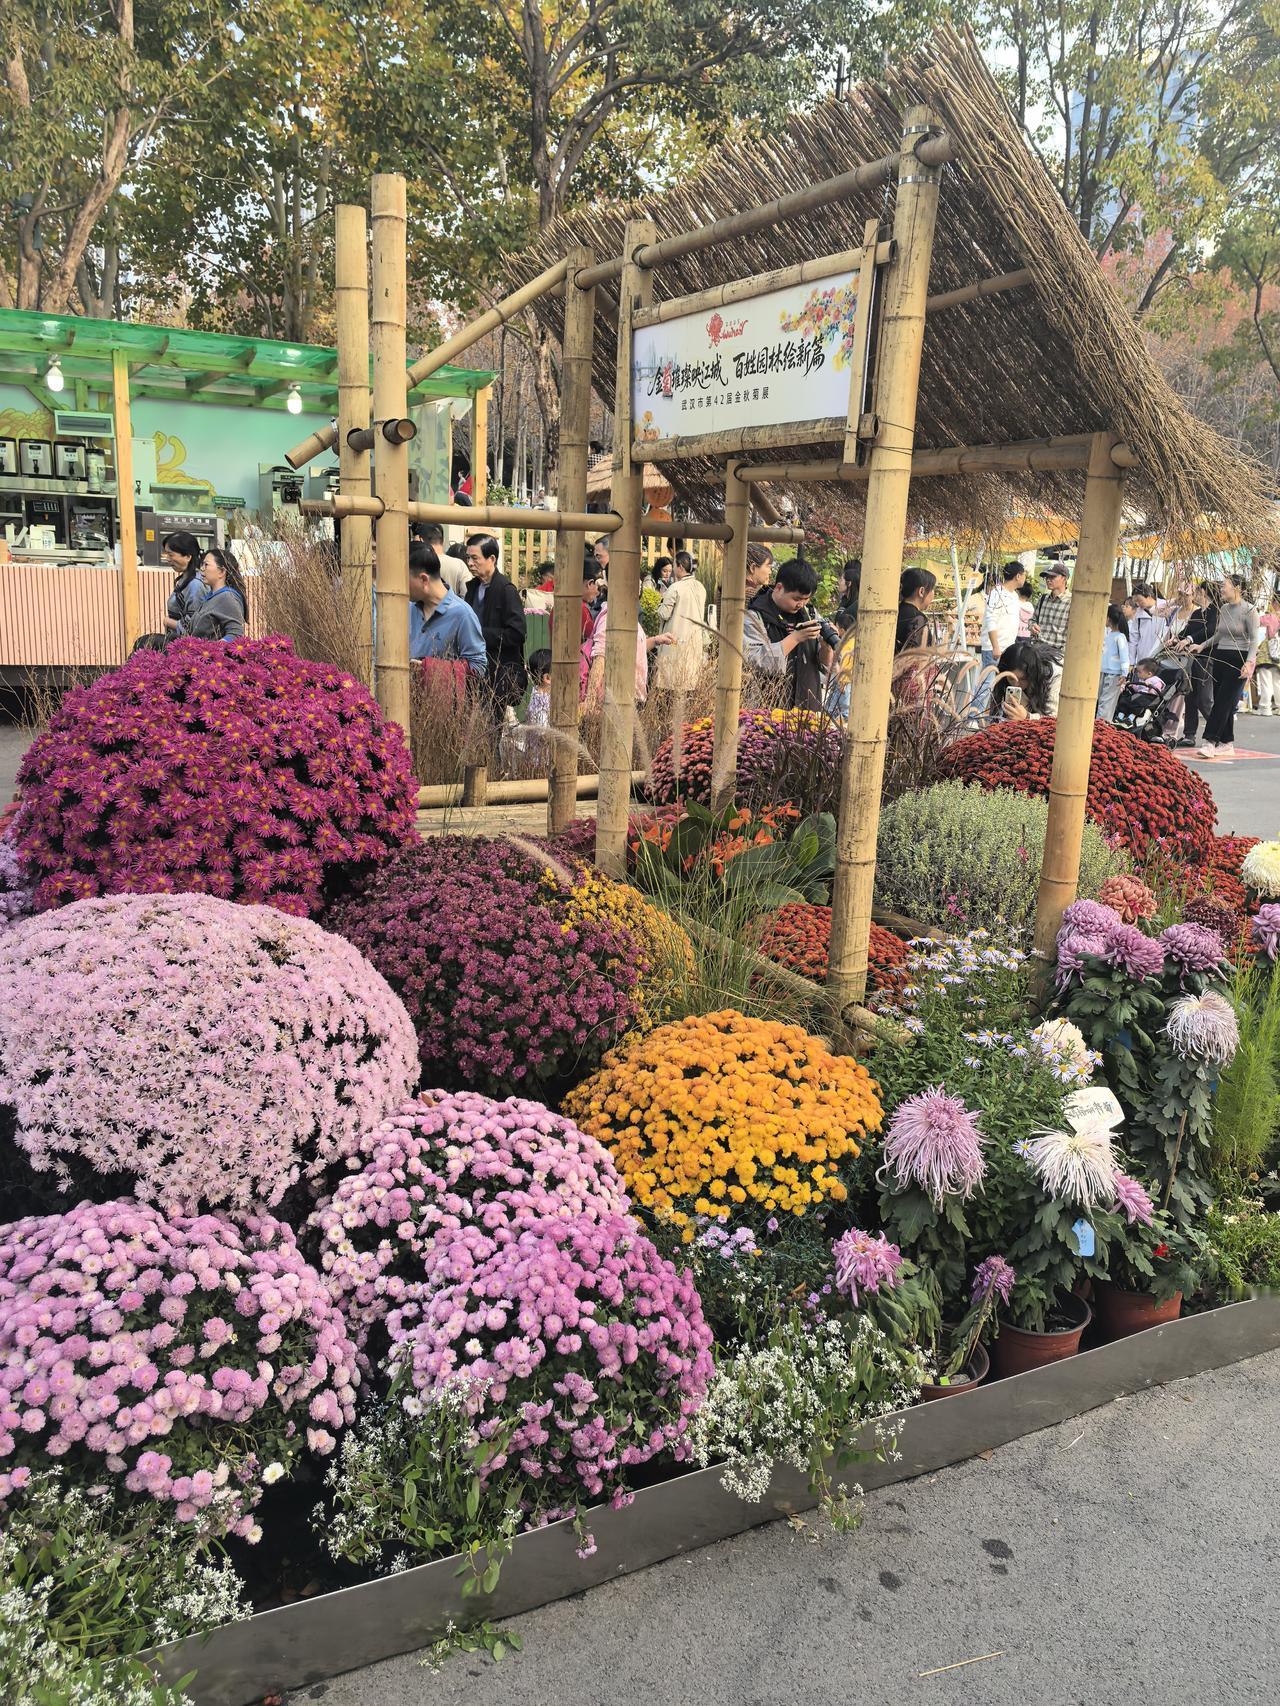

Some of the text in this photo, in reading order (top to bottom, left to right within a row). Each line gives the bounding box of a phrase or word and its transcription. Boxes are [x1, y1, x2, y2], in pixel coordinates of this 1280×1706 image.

[733, 333, 825, 379] 百姓园林绘新篇
[681, 386, 769, 411] 武汉市第42届金秋菊展
